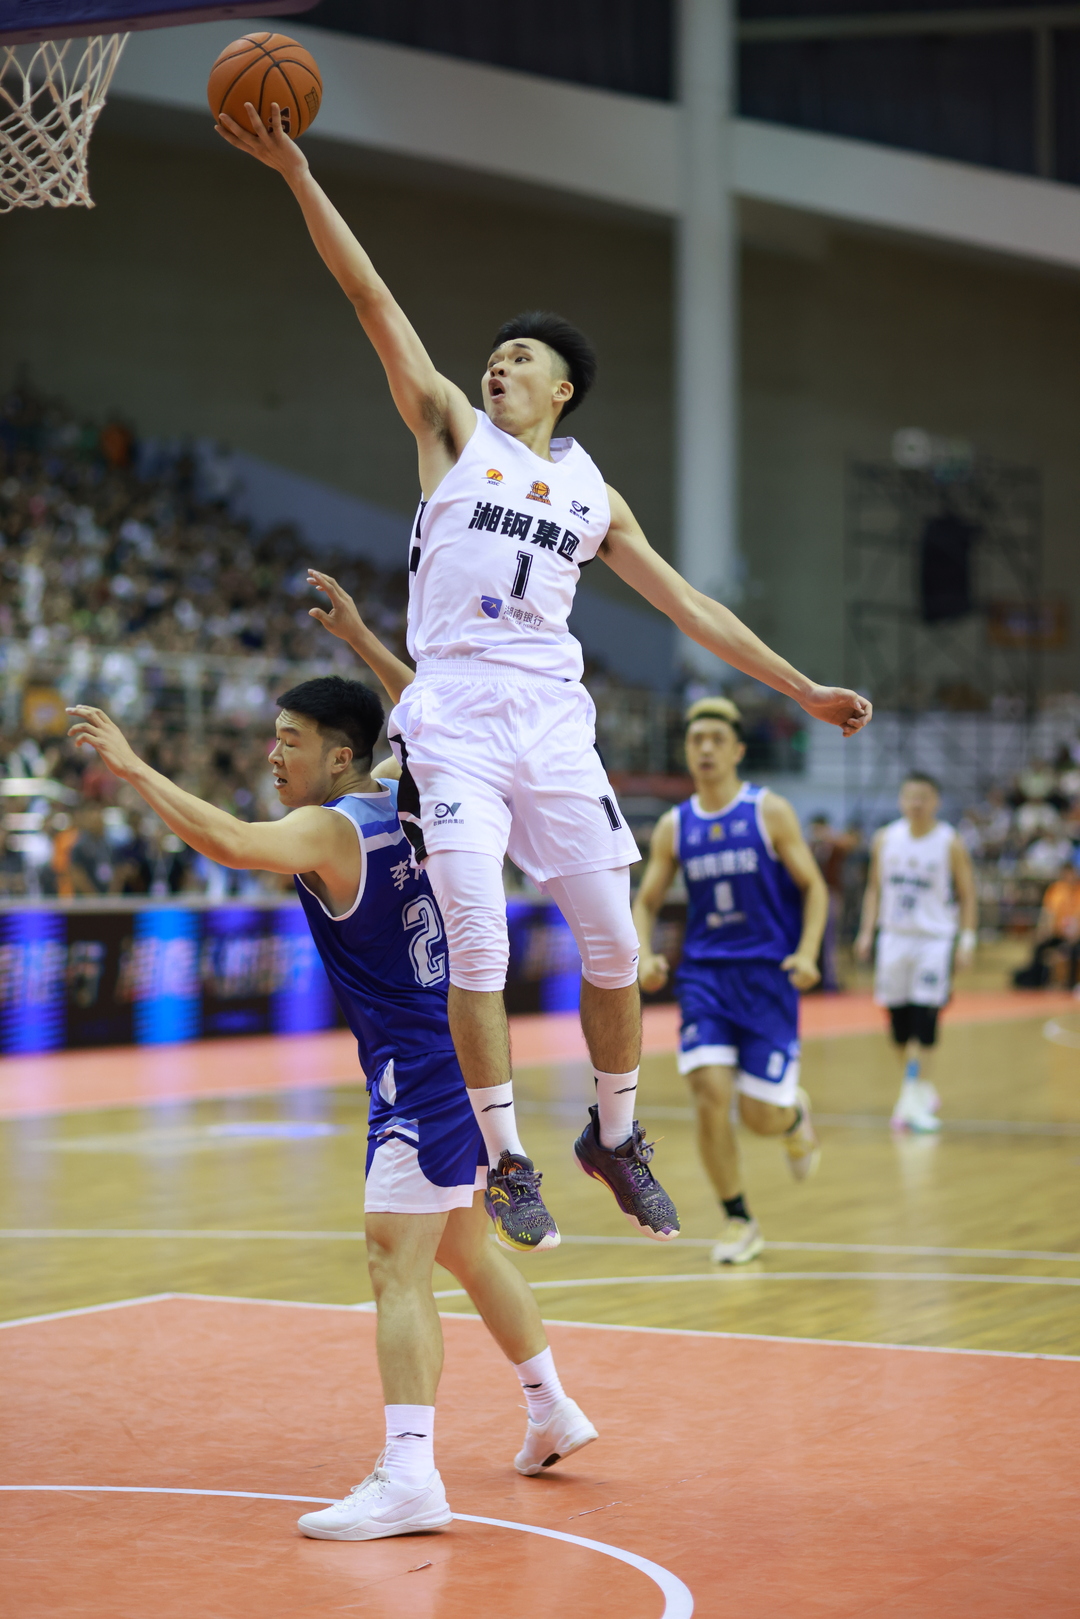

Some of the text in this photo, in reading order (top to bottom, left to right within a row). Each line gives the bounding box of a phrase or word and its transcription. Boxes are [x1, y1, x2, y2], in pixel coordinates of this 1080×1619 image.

[468, 501, 581, 563] 湘钢集团
[510, 550, 534, 600] 1
[503, 604, 544, 627] 湖南银行
[598, 794, 623, 832] 1
[389, 854, 424, 892] 李
[401, 894, 446, 988] 2
